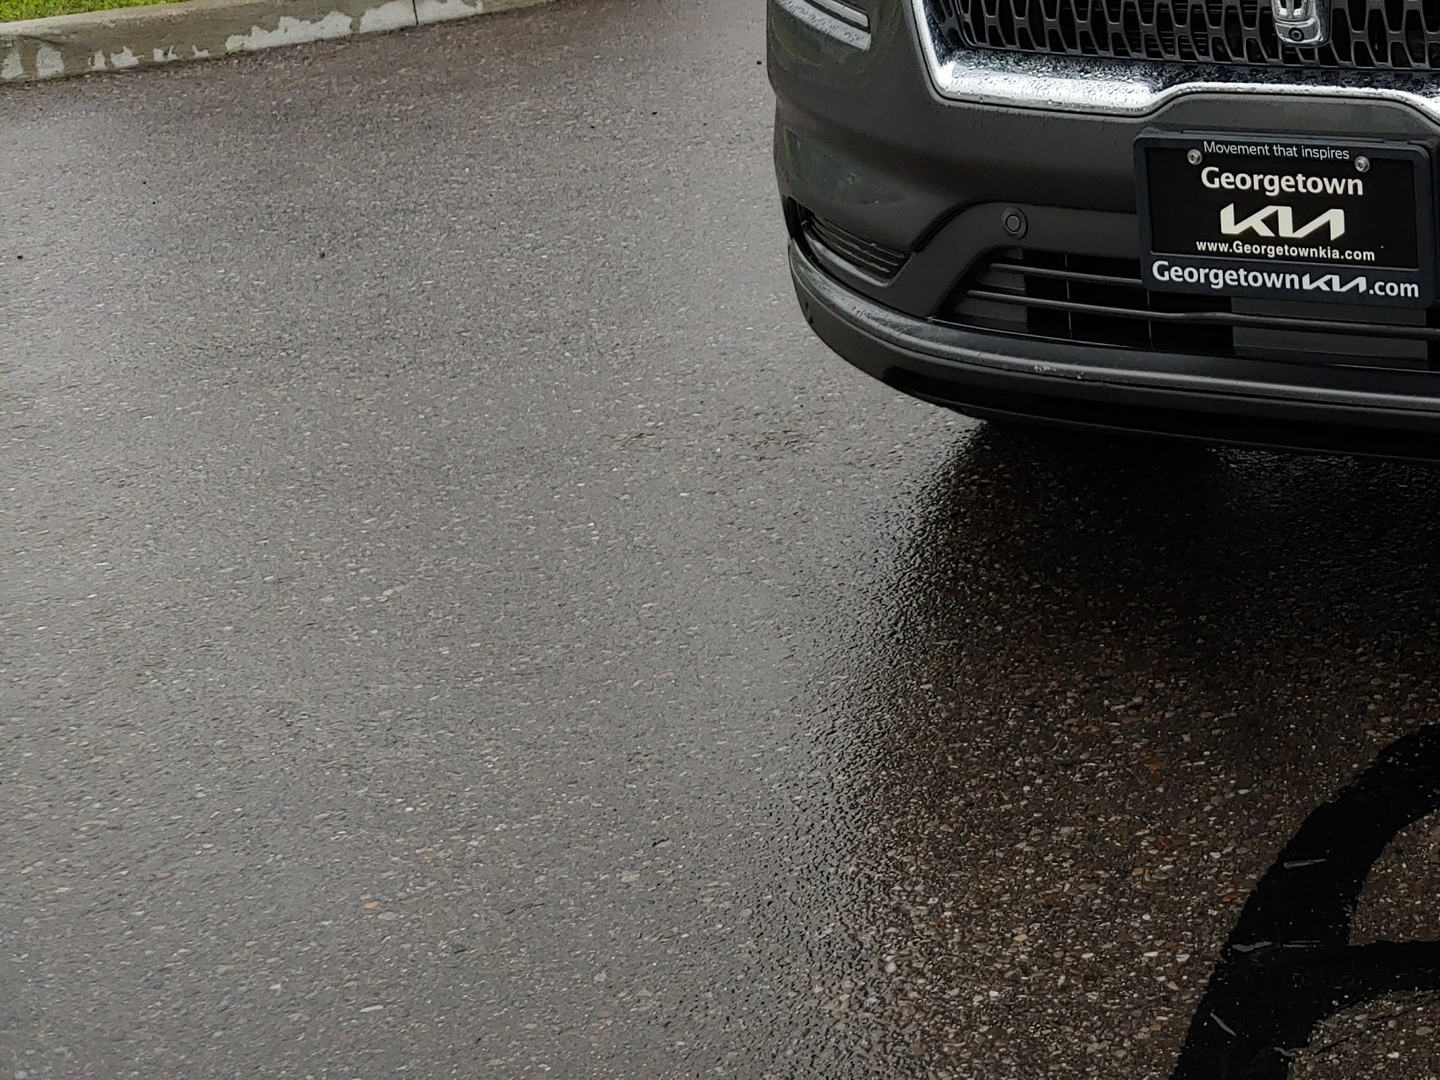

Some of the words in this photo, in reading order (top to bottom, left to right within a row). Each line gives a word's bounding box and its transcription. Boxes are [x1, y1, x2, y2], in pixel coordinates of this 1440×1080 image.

[1203, 141, 1270, 156] Movement
[1273, 143, 1298, 158] that
[1301, 145, 1350, 161] inspires
[1201, 166, 1364, 197] Georgetown
[1220, 203, 1345, 241] KIA
[1196, 240, 1376, 262] www.Georgetownkia.com
